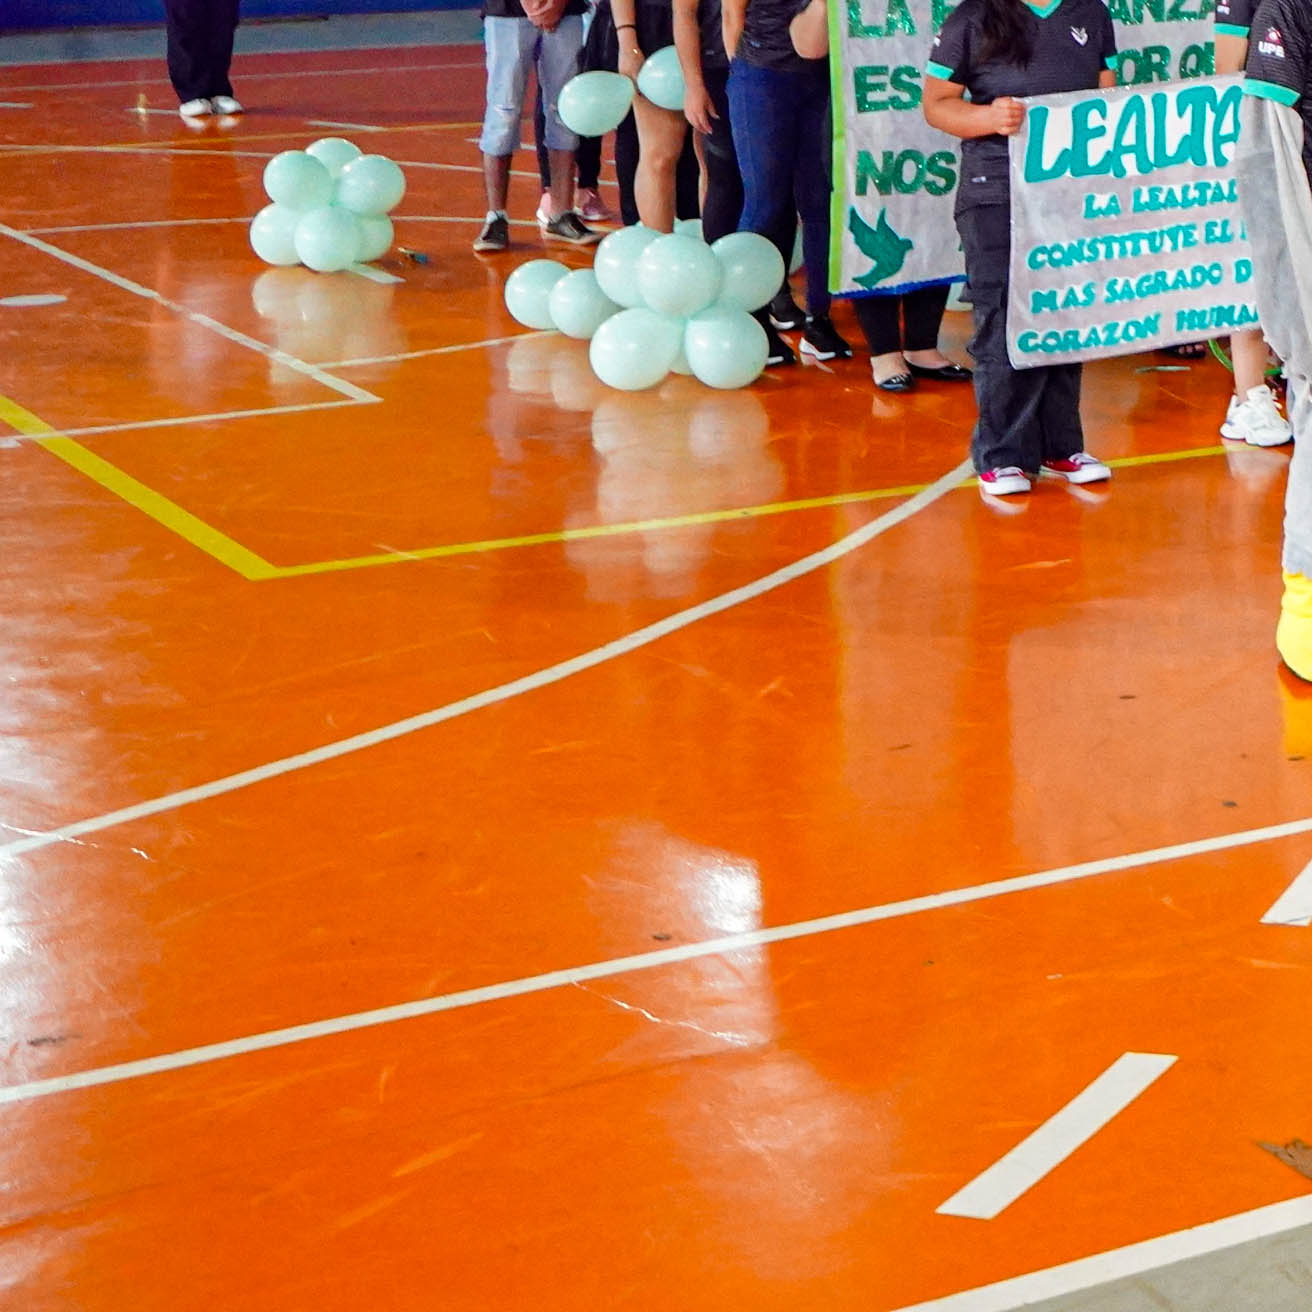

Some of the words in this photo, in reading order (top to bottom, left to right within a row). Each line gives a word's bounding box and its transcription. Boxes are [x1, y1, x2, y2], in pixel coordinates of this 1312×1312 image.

[853, 65, 922, 114] ES
[1024, 85, 1242, 183] LEALTA
[855, 148, 957, 196] NOS
[1083, 193, 1121, 219] LA
[1027, 223, 1198, 270] CONSTITUYE
[1204, 219, 1234, 244] EL
[1030, 282, 1097, 315] MAS
[1103, 262, 1225, 305] SAGRADO
[1234, 259, 1253, 284] D
[1016, 312, 1162, 354] CORAZON
